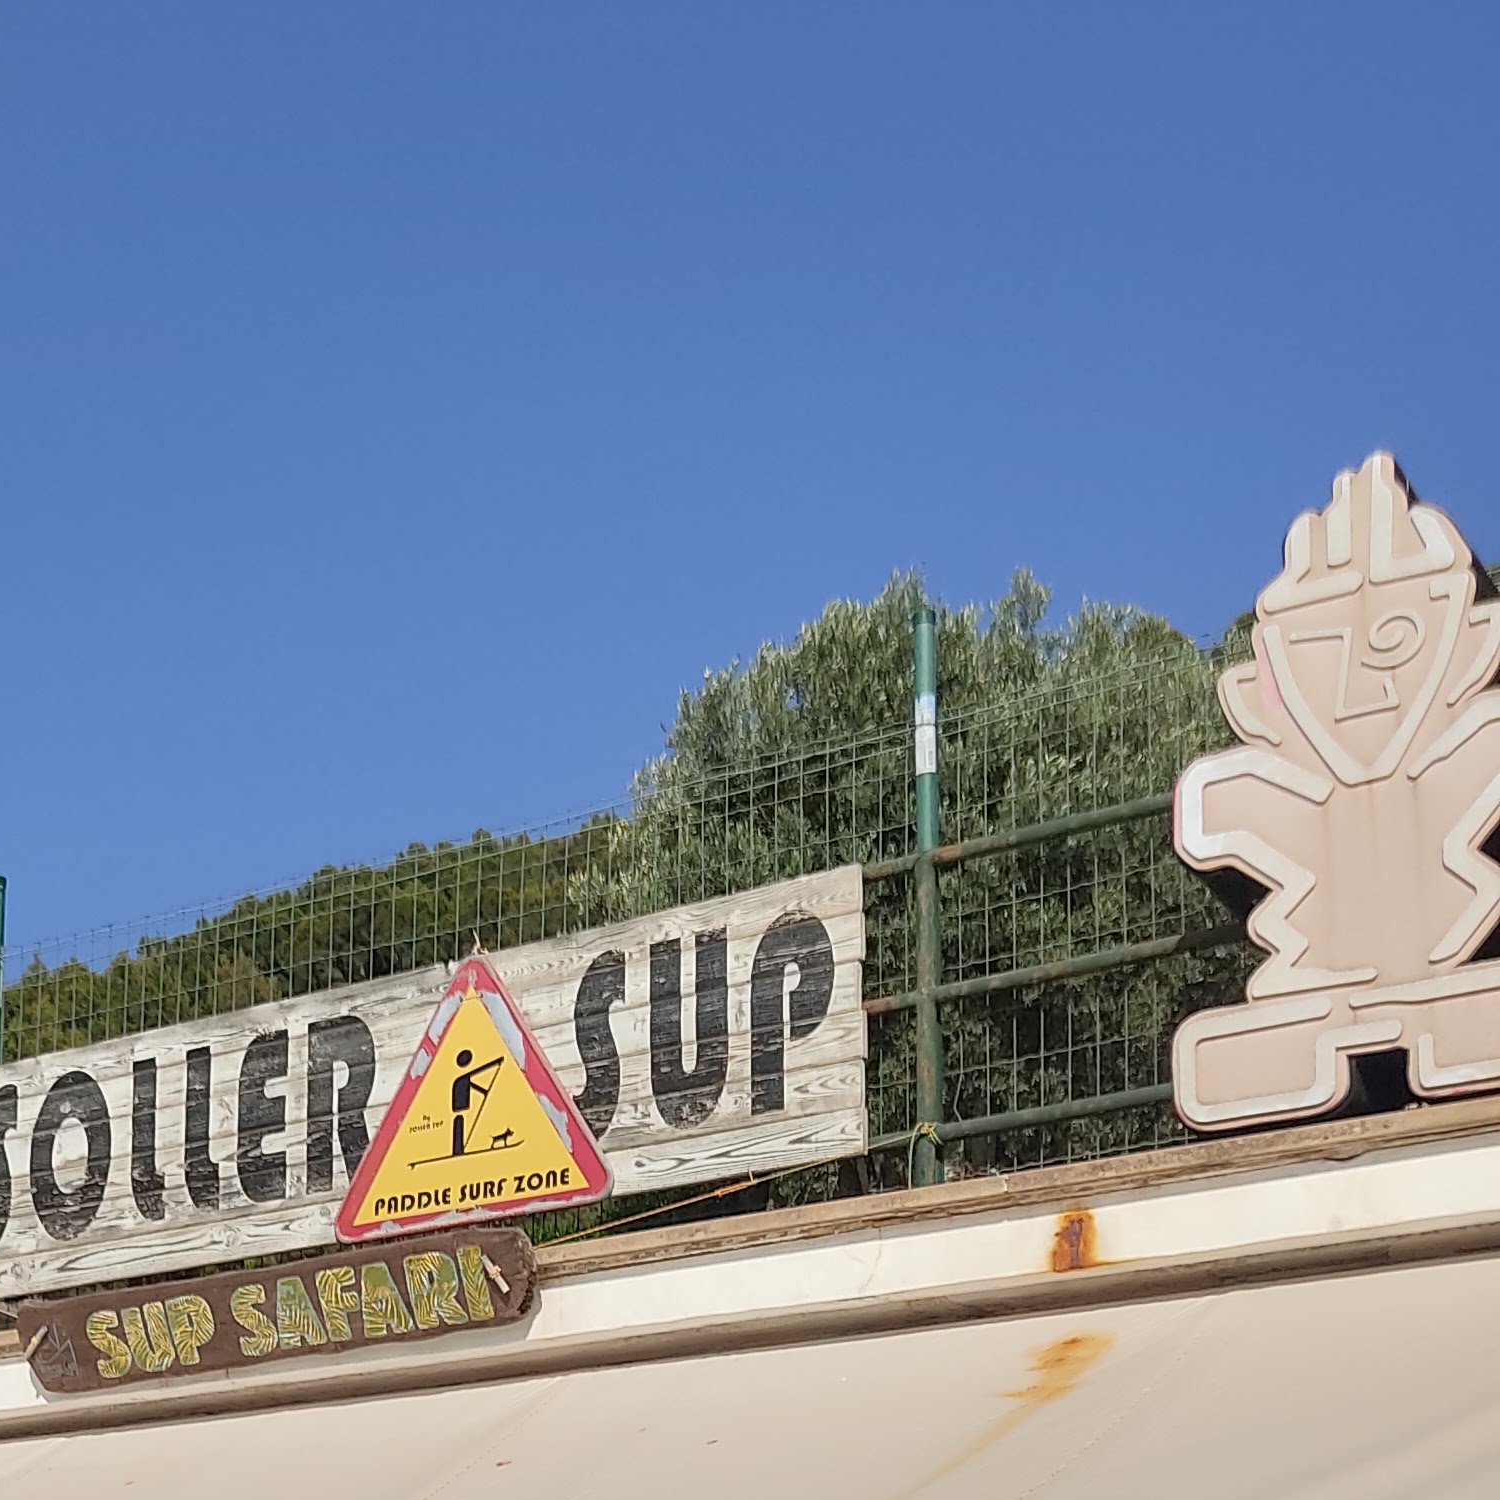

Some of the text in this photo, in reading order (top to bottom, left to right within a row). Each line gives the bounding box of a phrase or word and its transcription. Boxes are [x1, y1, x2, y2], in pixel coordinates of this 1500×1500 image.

[575, 910, 834, 1138] SUP
[374, 1167, 570, 1216] PADDLE SURF ZONE
[85, 1245, 496, 1379] SUP SAFARI
